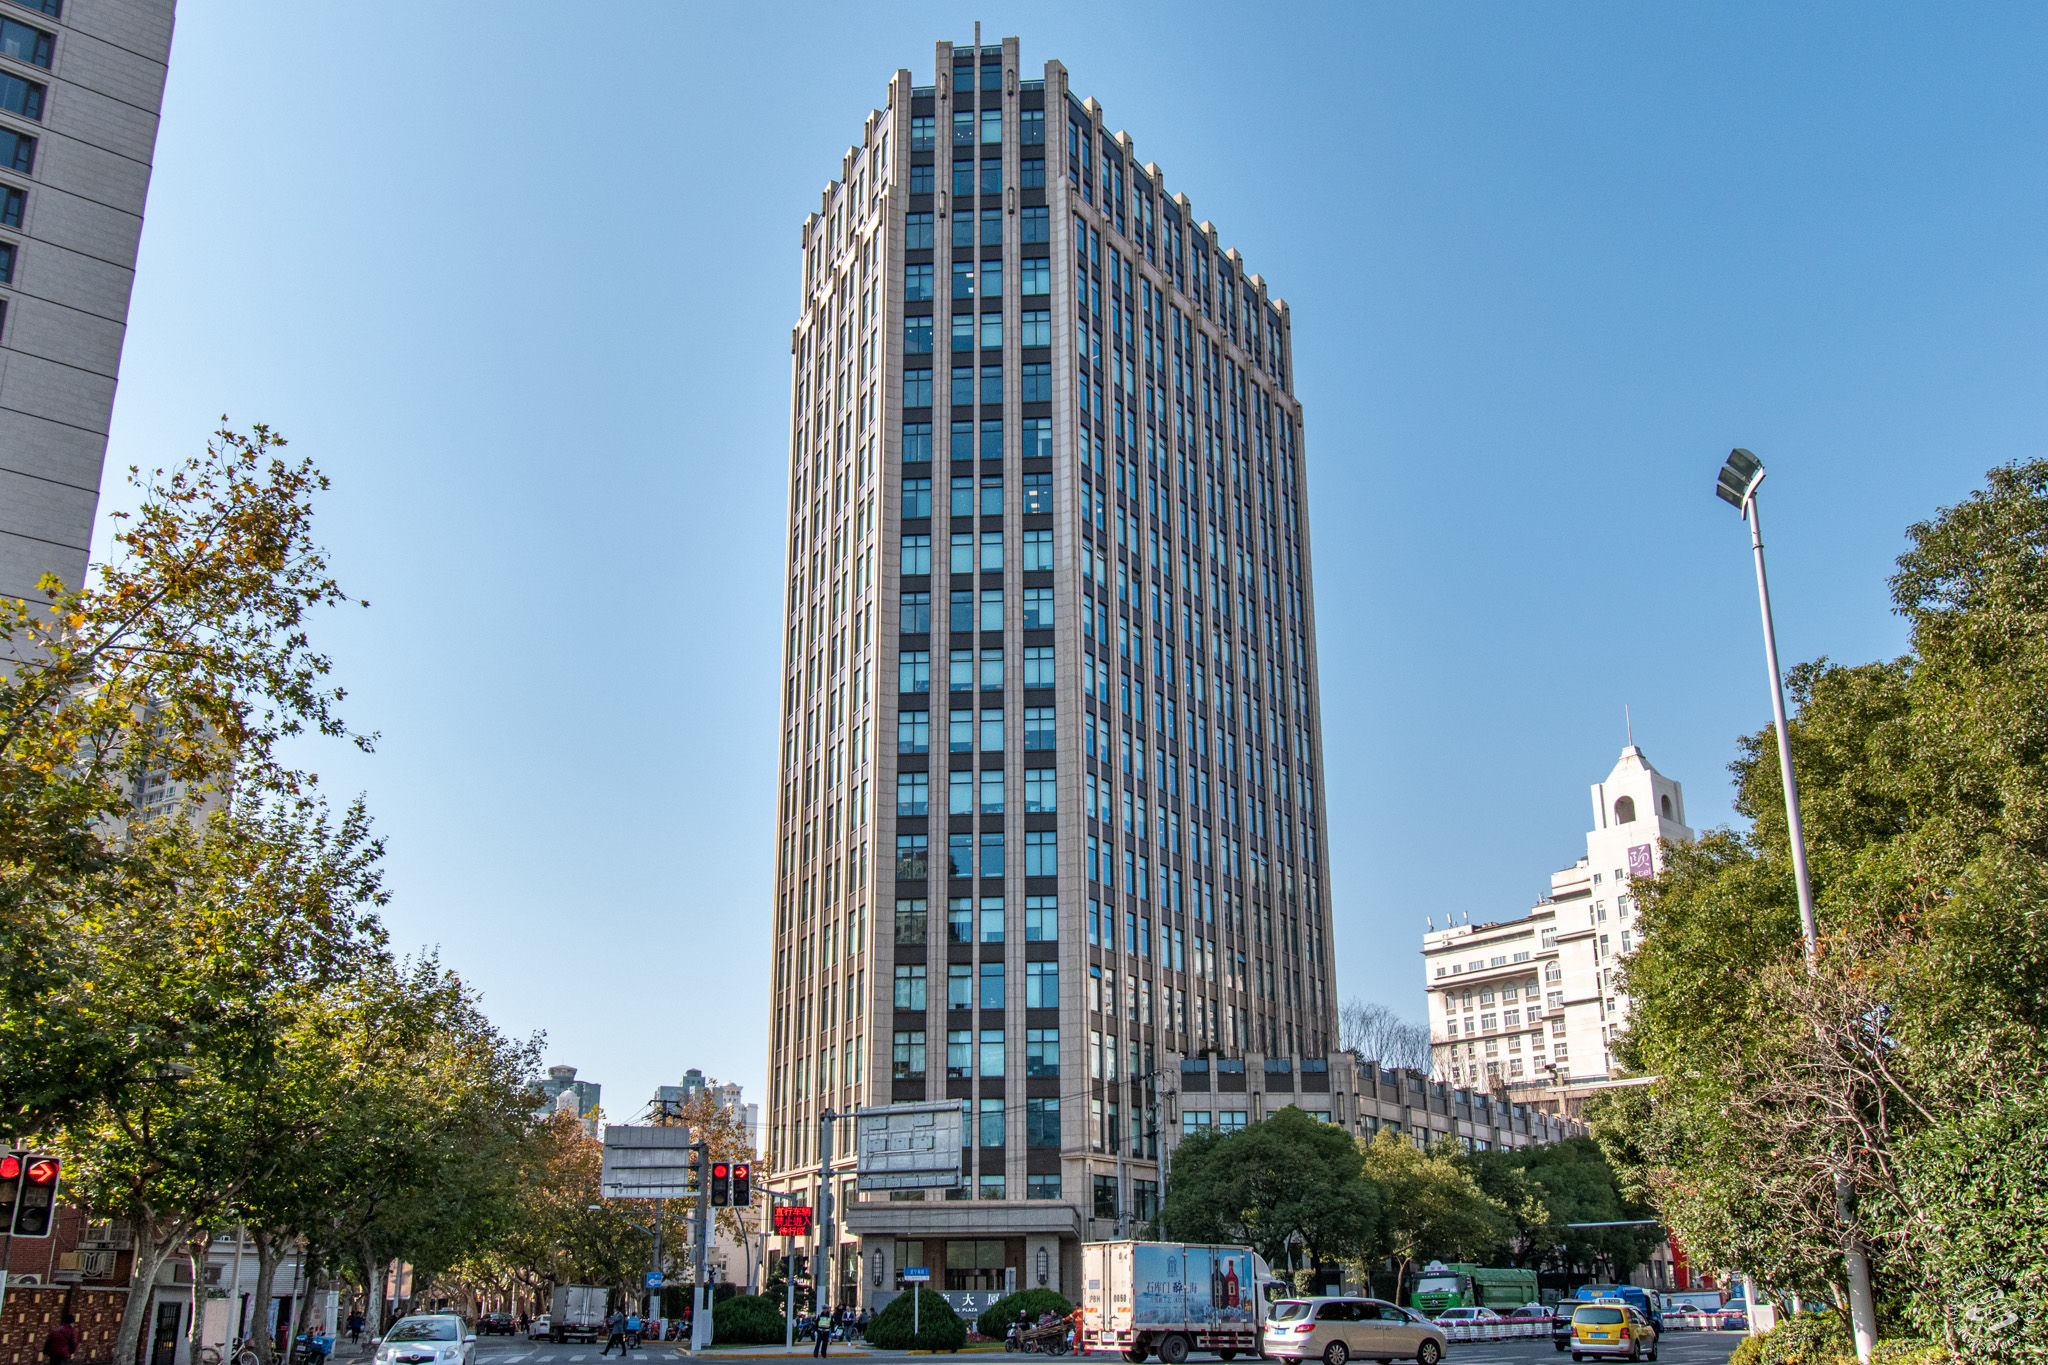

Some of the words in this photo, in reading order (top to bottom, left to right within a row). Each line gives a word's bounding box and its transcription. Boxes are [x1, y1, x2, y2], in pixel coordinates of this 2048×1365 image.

[775, 1207, 811, 1216] 直行车辆
[775, 1216, 812, 1226] 禁止进入
[778, 1227, 806, 1236] 待行区
